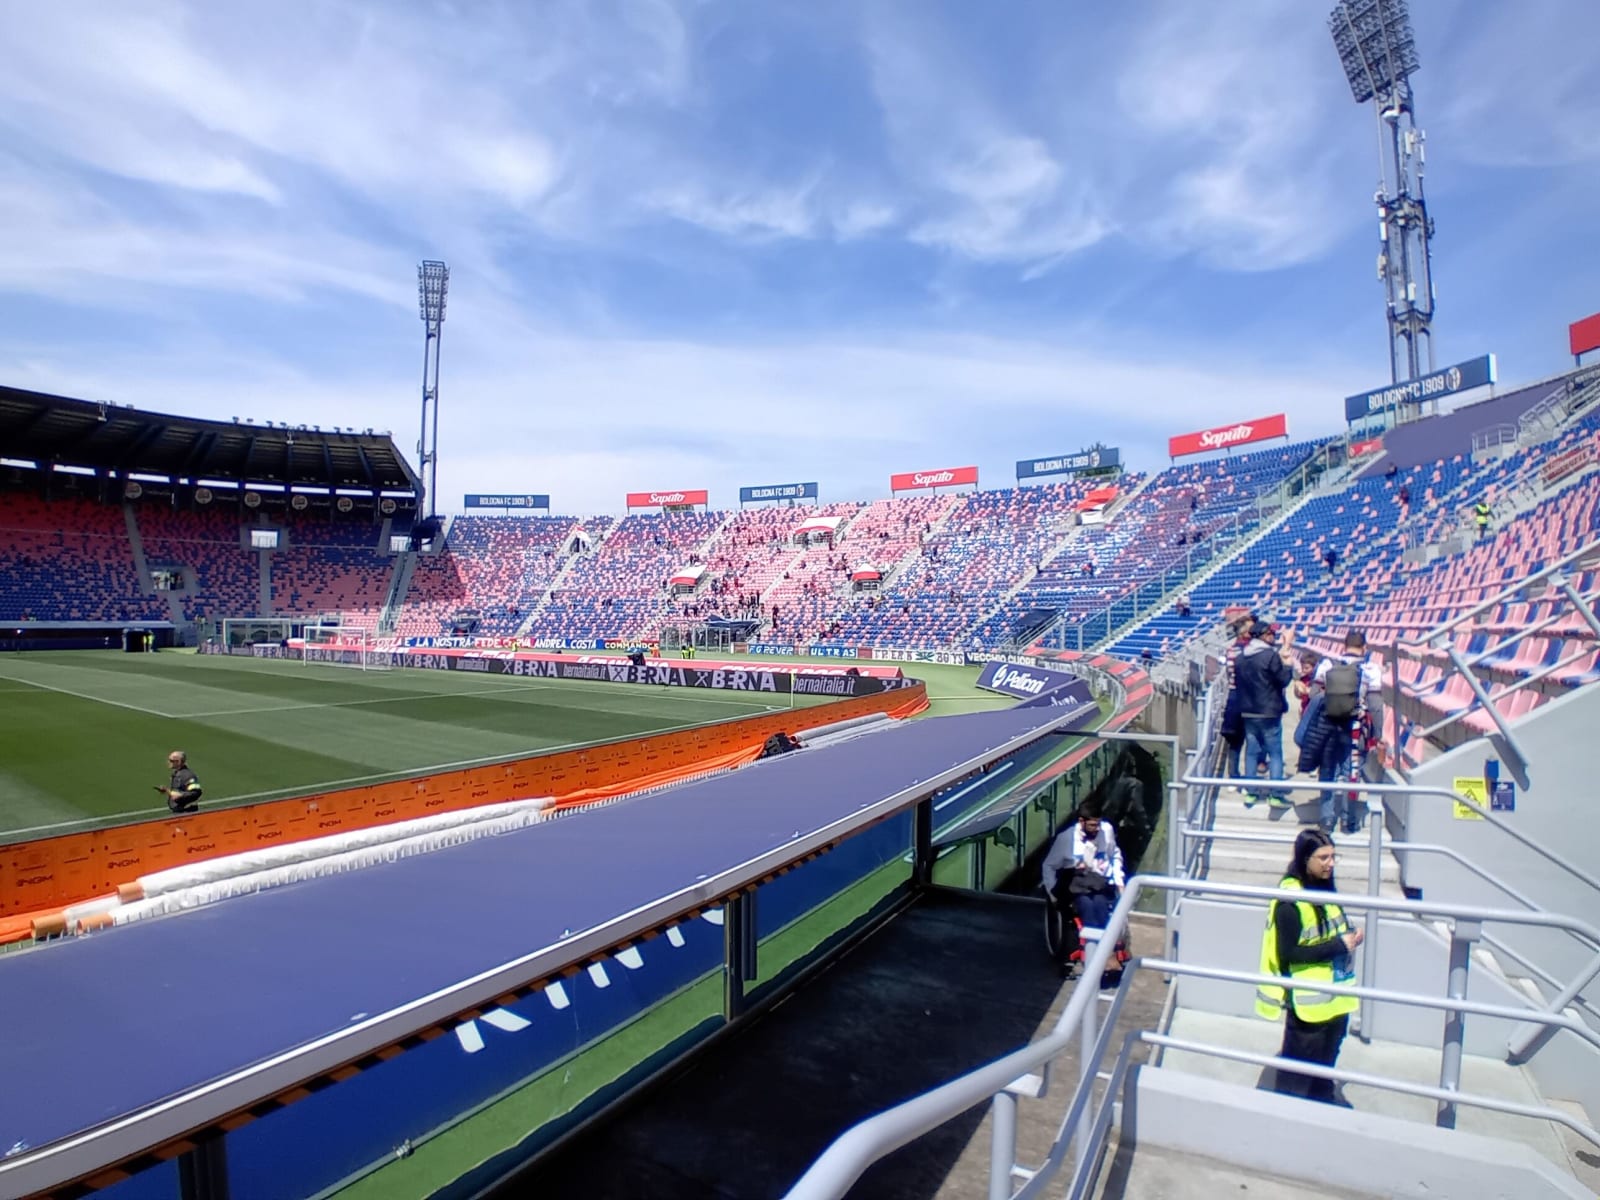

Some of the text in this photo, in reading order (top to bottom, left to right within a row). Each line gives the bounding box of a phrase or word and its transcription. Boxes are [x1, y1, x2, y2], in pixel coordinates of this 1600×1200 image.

[1422, 375, 1444, 393] 1909
[1199, 424, 1254, 448] Saputo
[1034, 455, 1089, 473] BOLOGNA FC 1909
[912, 471, 954, 487] Saputo
[648, 492, 686, 504] Saputo
[752, 486, 795, 498] BOLOGNA FC 1909
[479, 497, 504, 505] BOLOGNA
[504, 497, 511, 505] FC
[416, 638, 429, 647] LA
[432, 637, 471, 648] NOSTRA
[534, 638, 566, 649] ANDREA
[570, 639, 597, 649] COSTA
[810, 648, 857, 657] ULTRAS
[414, 655, 449, 670] BERNA
[514, 660, 558, 678] BERNA
[627, 664, 687, 686] BERNA
[711, 670, 776, 692] BERNA
